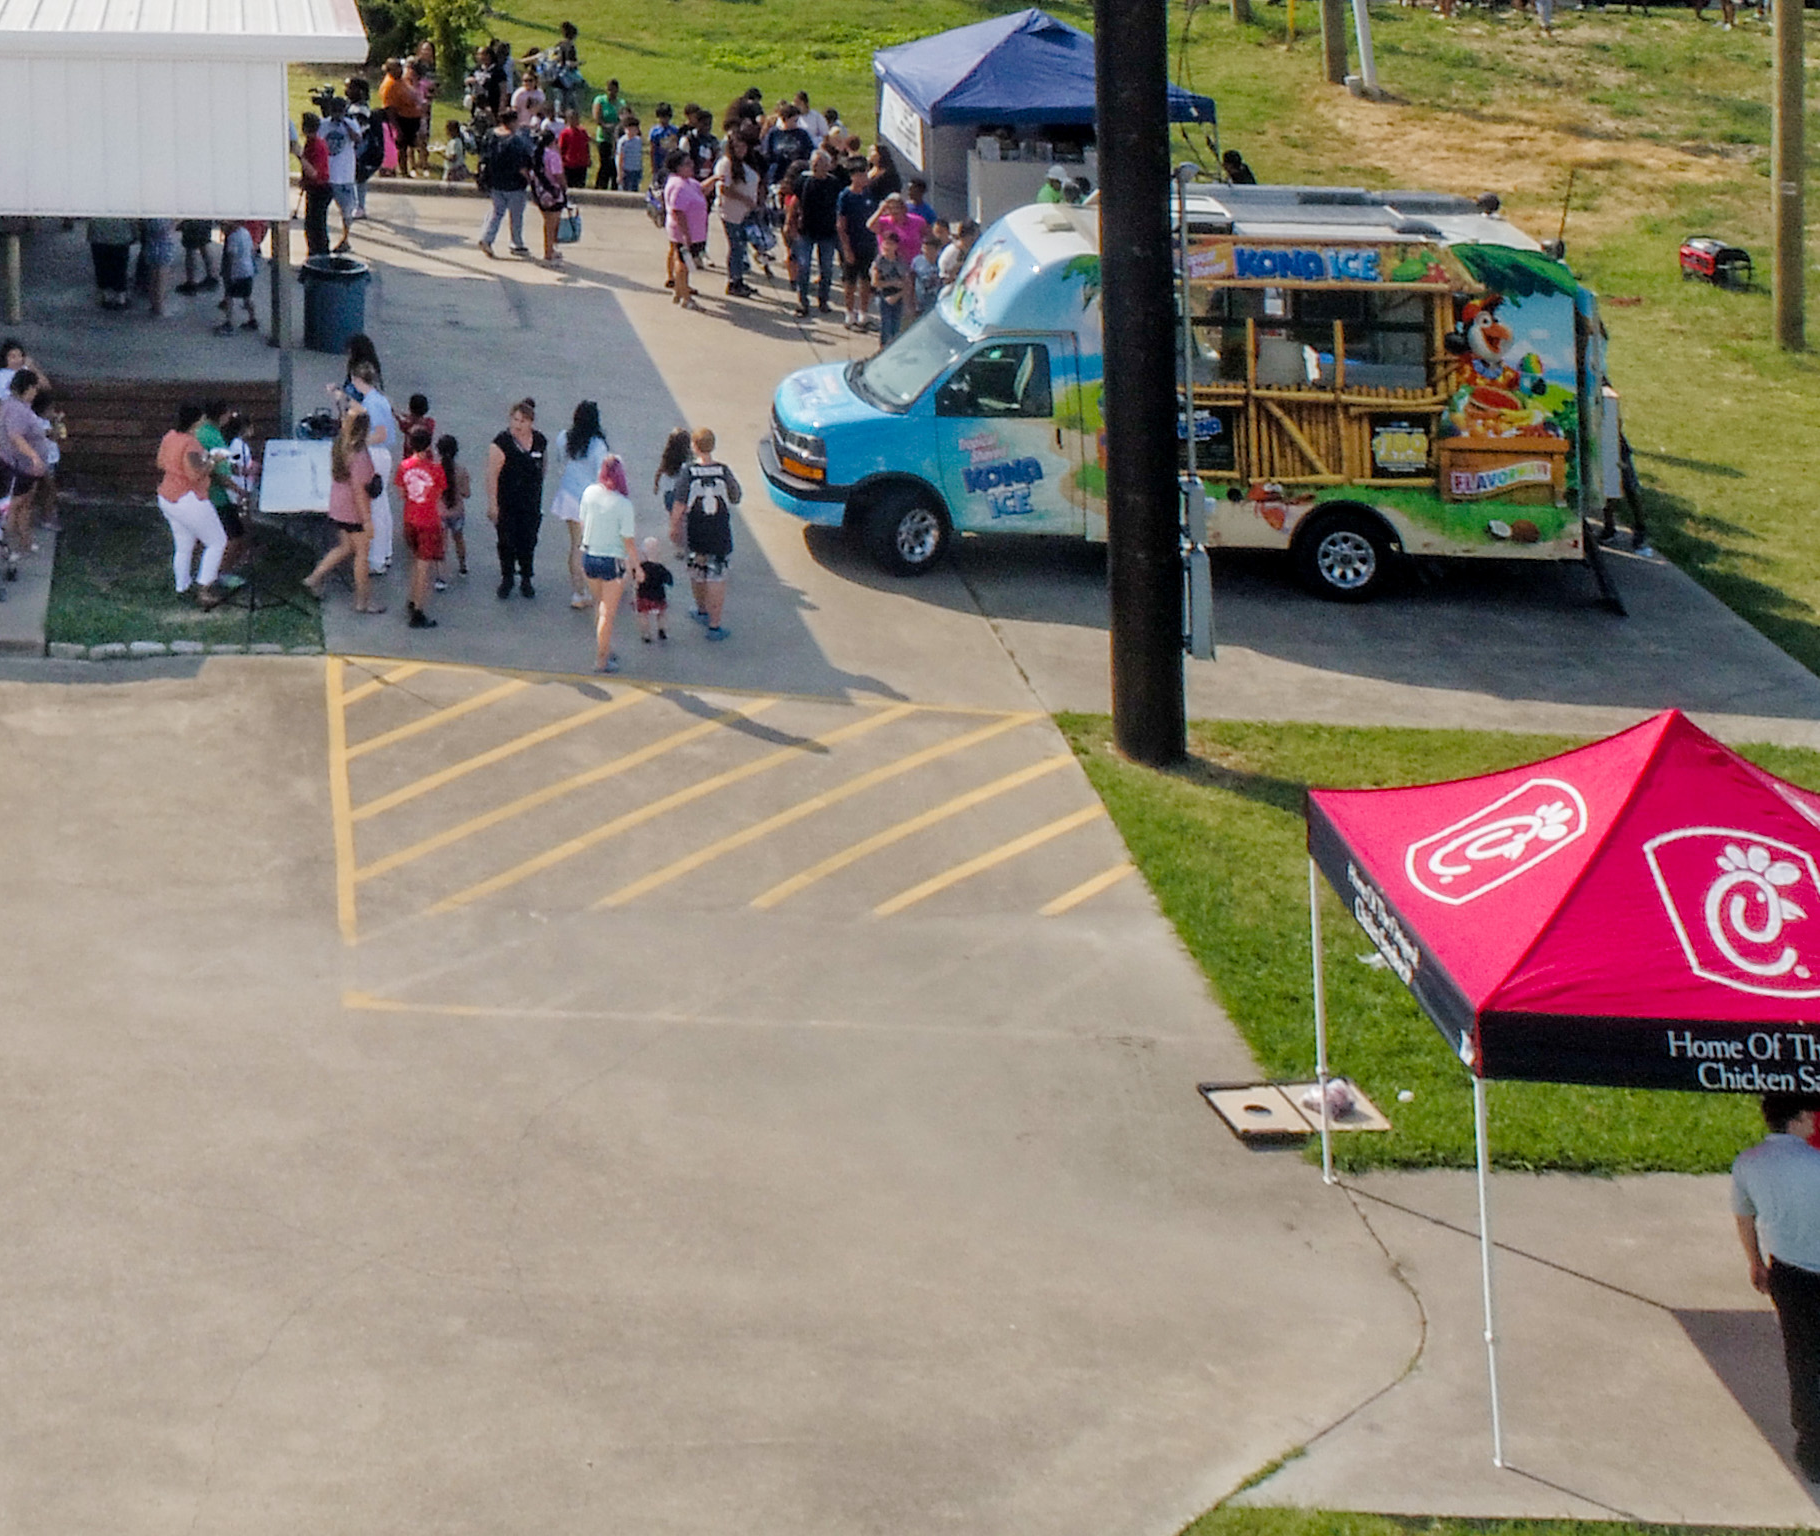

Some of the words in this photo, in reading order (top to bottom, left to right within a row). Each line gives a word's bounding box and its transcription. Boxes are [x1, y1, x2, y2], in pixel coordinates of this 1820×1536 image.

[1234, 247, 1325, 281] KONA
[1327, 247, 1383, 282] ICE
[962, 456, 1043, 493] KONA
[1667, 1030, 1744, 1060] Home
[1747, 1032, 1782, 1060] Of
[1697, 1061, 1797, 1092] Chicken
